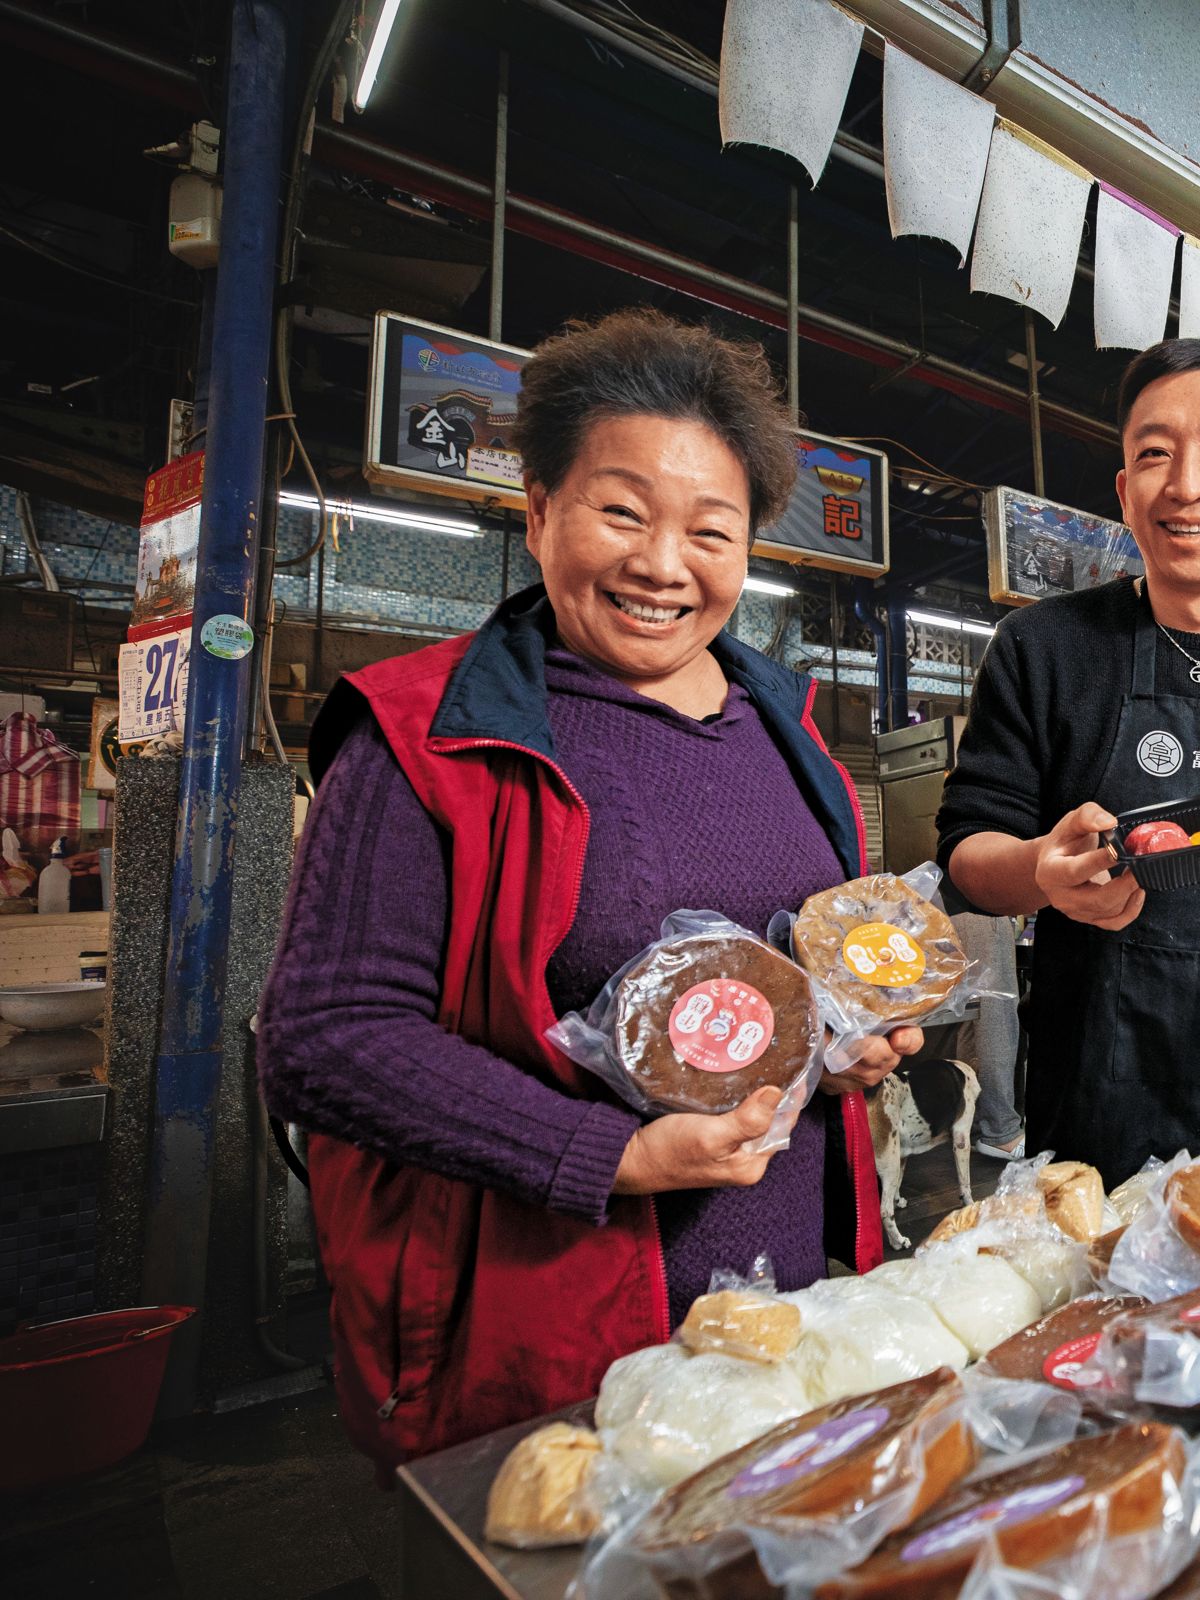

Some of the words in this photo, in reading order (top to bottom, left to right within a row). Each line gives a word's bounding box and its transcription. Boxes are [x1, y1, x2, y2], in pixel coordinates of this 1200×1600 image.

[416, 408, 465, 469] 金山
[822, 494, 862, 541] 記
[144, 638, 179, 712] 27
[146, 708, 172, 726] 星期五
